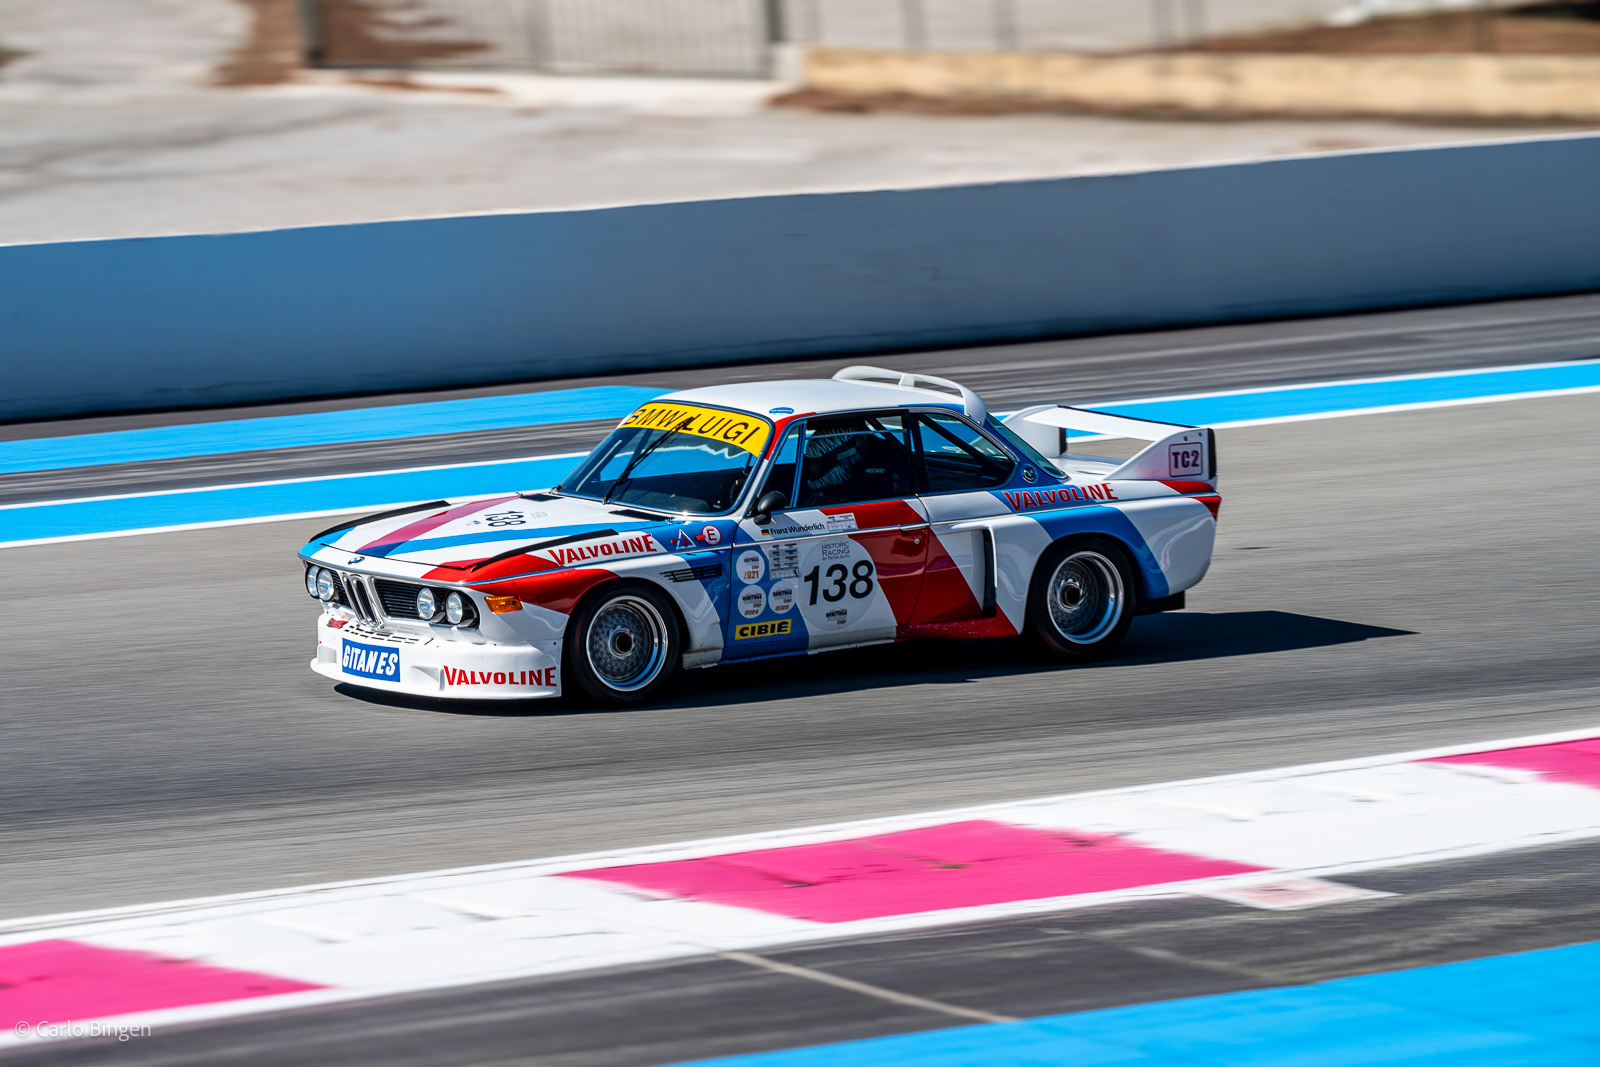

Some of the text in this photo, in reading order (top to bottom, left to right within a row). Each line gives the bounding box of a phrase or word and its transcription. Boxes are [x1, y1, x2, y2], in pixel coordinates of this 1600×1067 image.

[623, 408, 761, 445] BMW LUIGI
[1172, 449, 1200, 469] TC2
[1002, 482, 1119, 512] VALVOLINE
[484, 511, 527, 527] 138
[770, 522, 825, 535] Franz Wunderlich
[706, 528, 717, 542] E
[547, 533, 658, 567] VALVOLINE
[821, 541, 850, 550] HISTORIC
[821, 547, 850, 557] RACING
[743, 570, 760, 580] 2021
[803, 560, 874, 606] 138
[342, 645, 398, 676] GITANES
[443, 665, 558, 687] VALVOLINE
